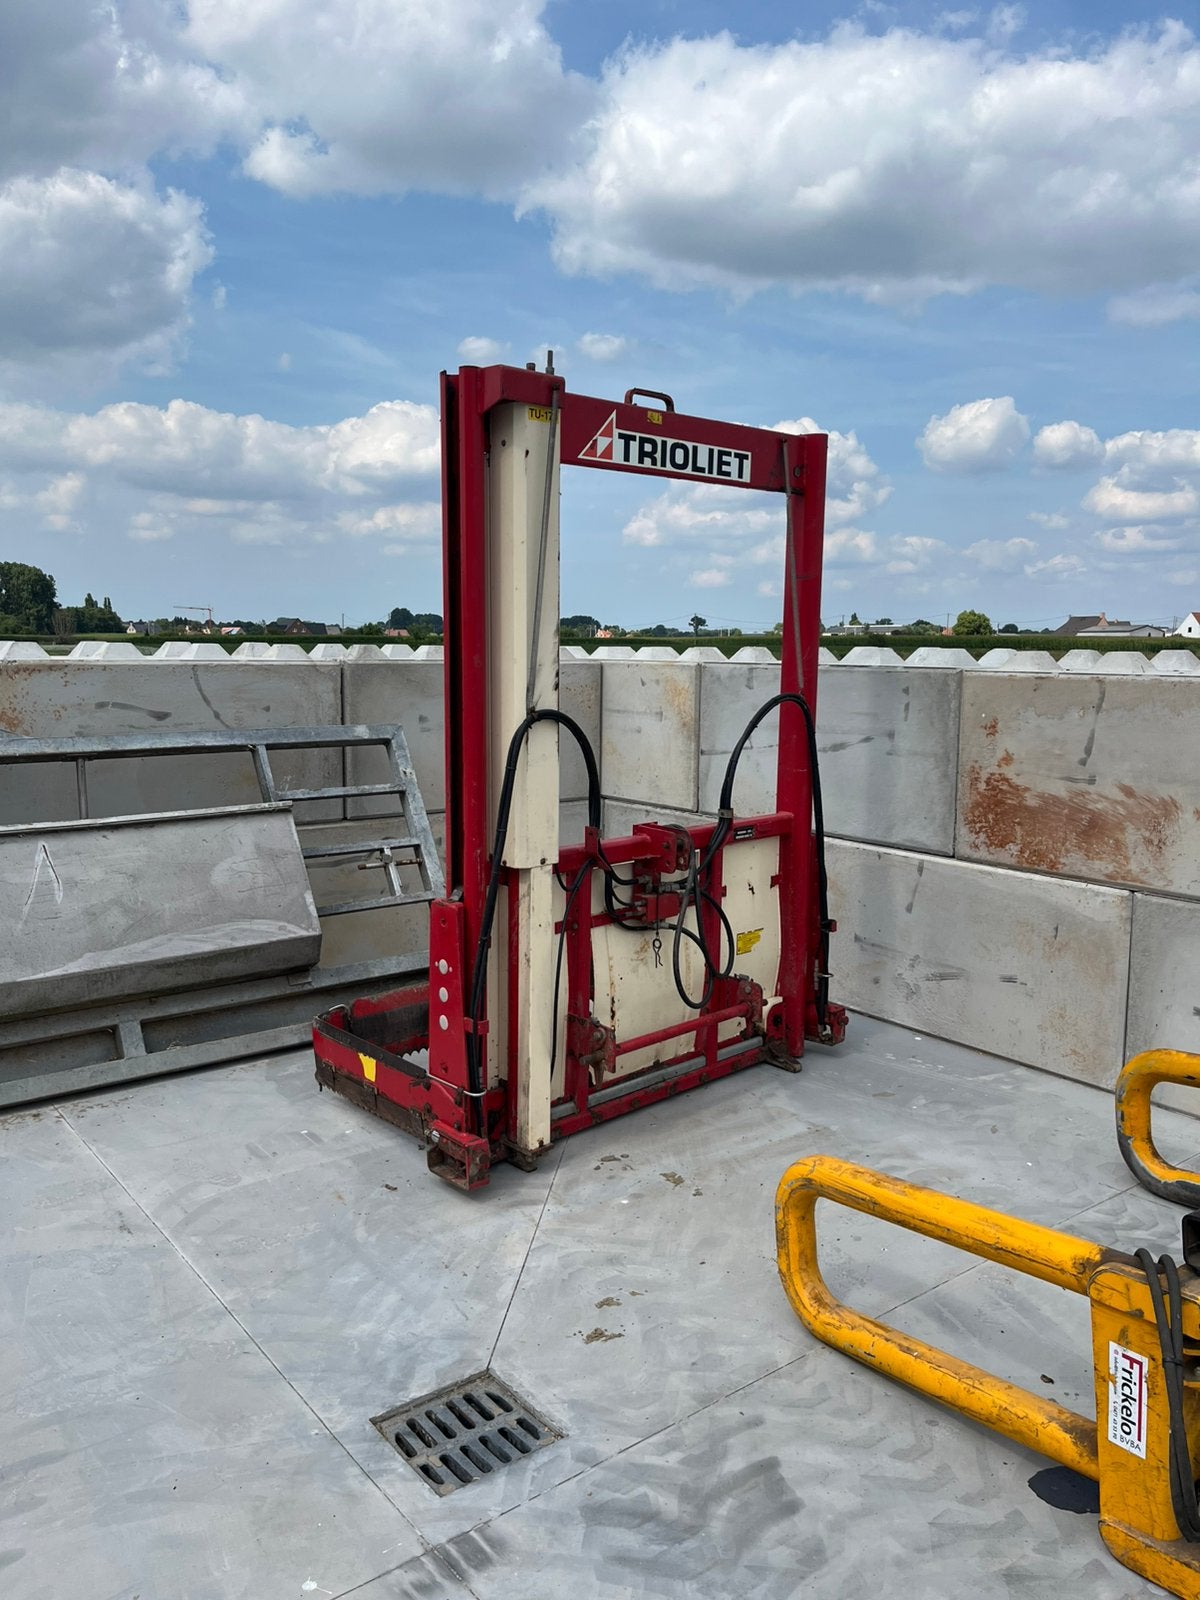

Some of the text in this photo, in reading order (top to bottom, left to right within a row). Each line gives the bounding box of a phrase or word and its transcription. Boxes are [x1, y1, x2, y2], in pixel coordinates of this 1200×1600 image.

[617, 432, 750, 480] TRIOLIET
[1121, 1352, 1143, 1436] Frickelo
[1119, 1434, 1142, 1452] BVBA
